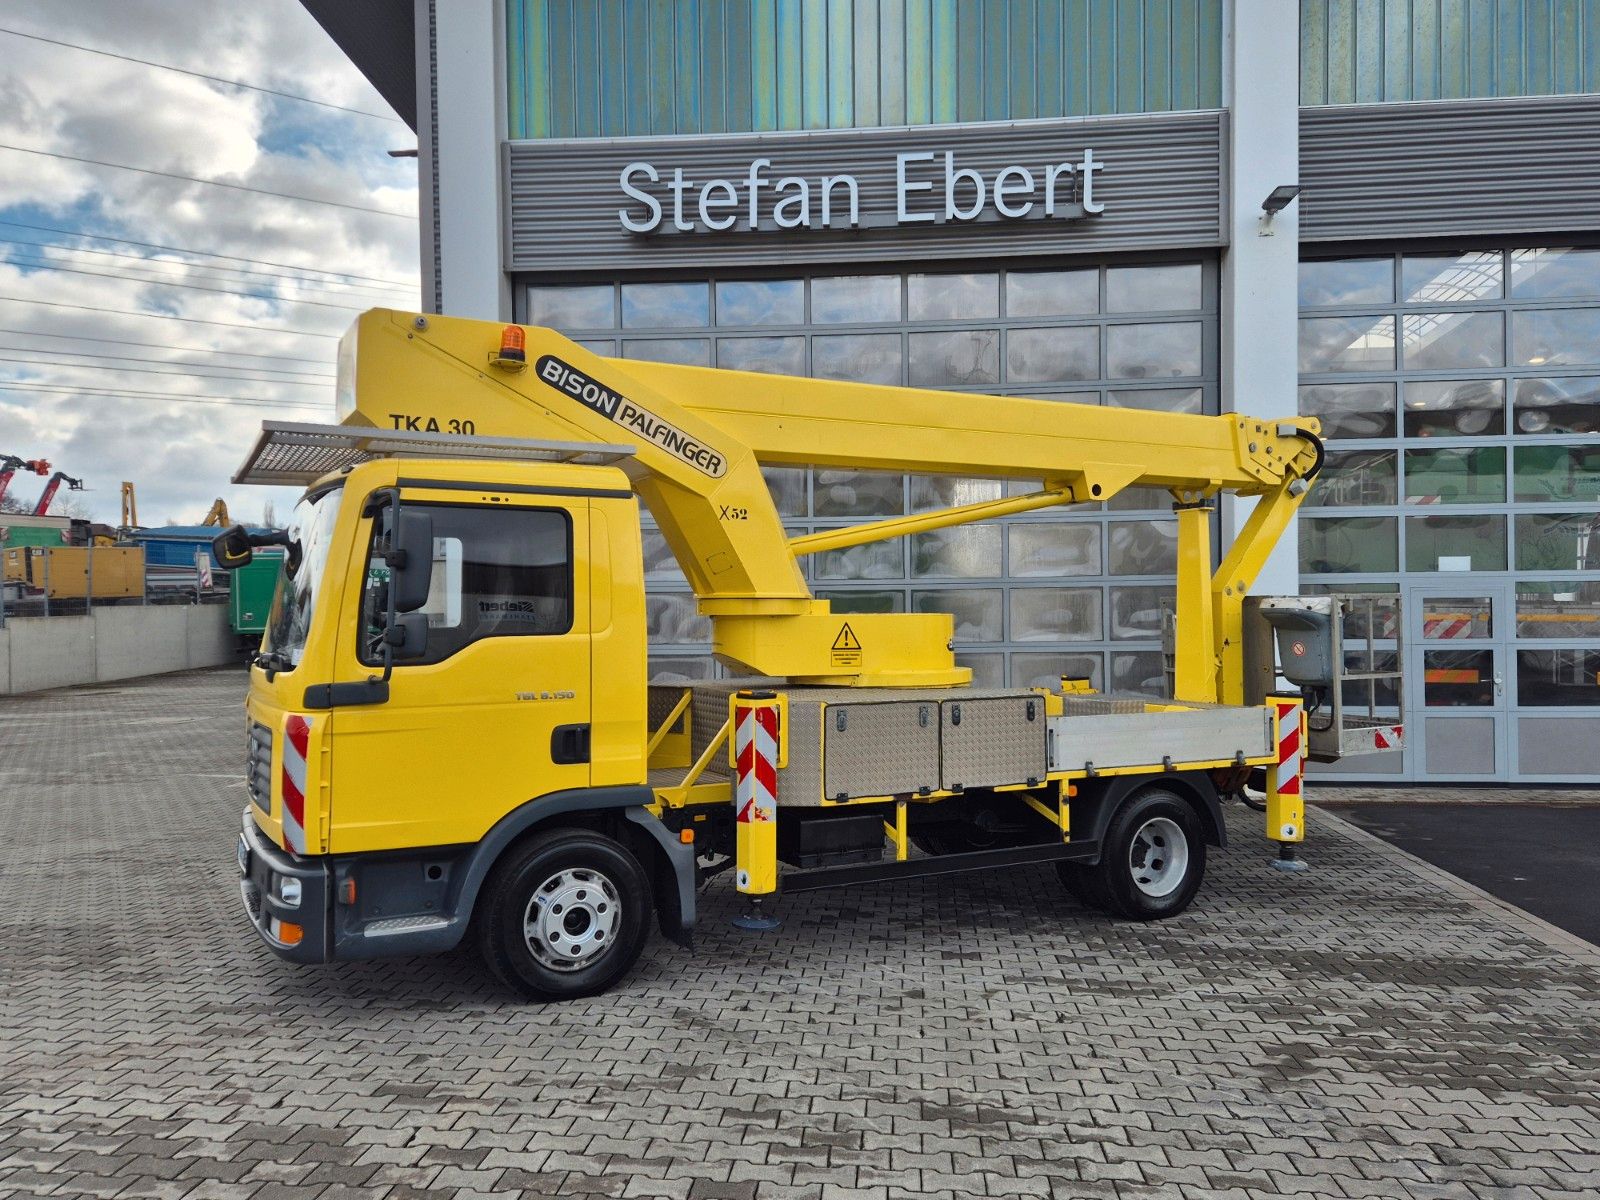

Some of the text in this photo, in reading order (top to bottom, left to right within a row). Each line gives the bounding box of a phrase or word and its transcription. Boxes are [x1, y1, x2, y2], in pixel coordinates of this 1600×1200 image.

[618, 147, 1105, 232] Stefan Ebert
[541, 359, 619, 414] BISON
[389, 413, 475, 436] TKA 30
[618, 403, 723, 475] PALFINGER
